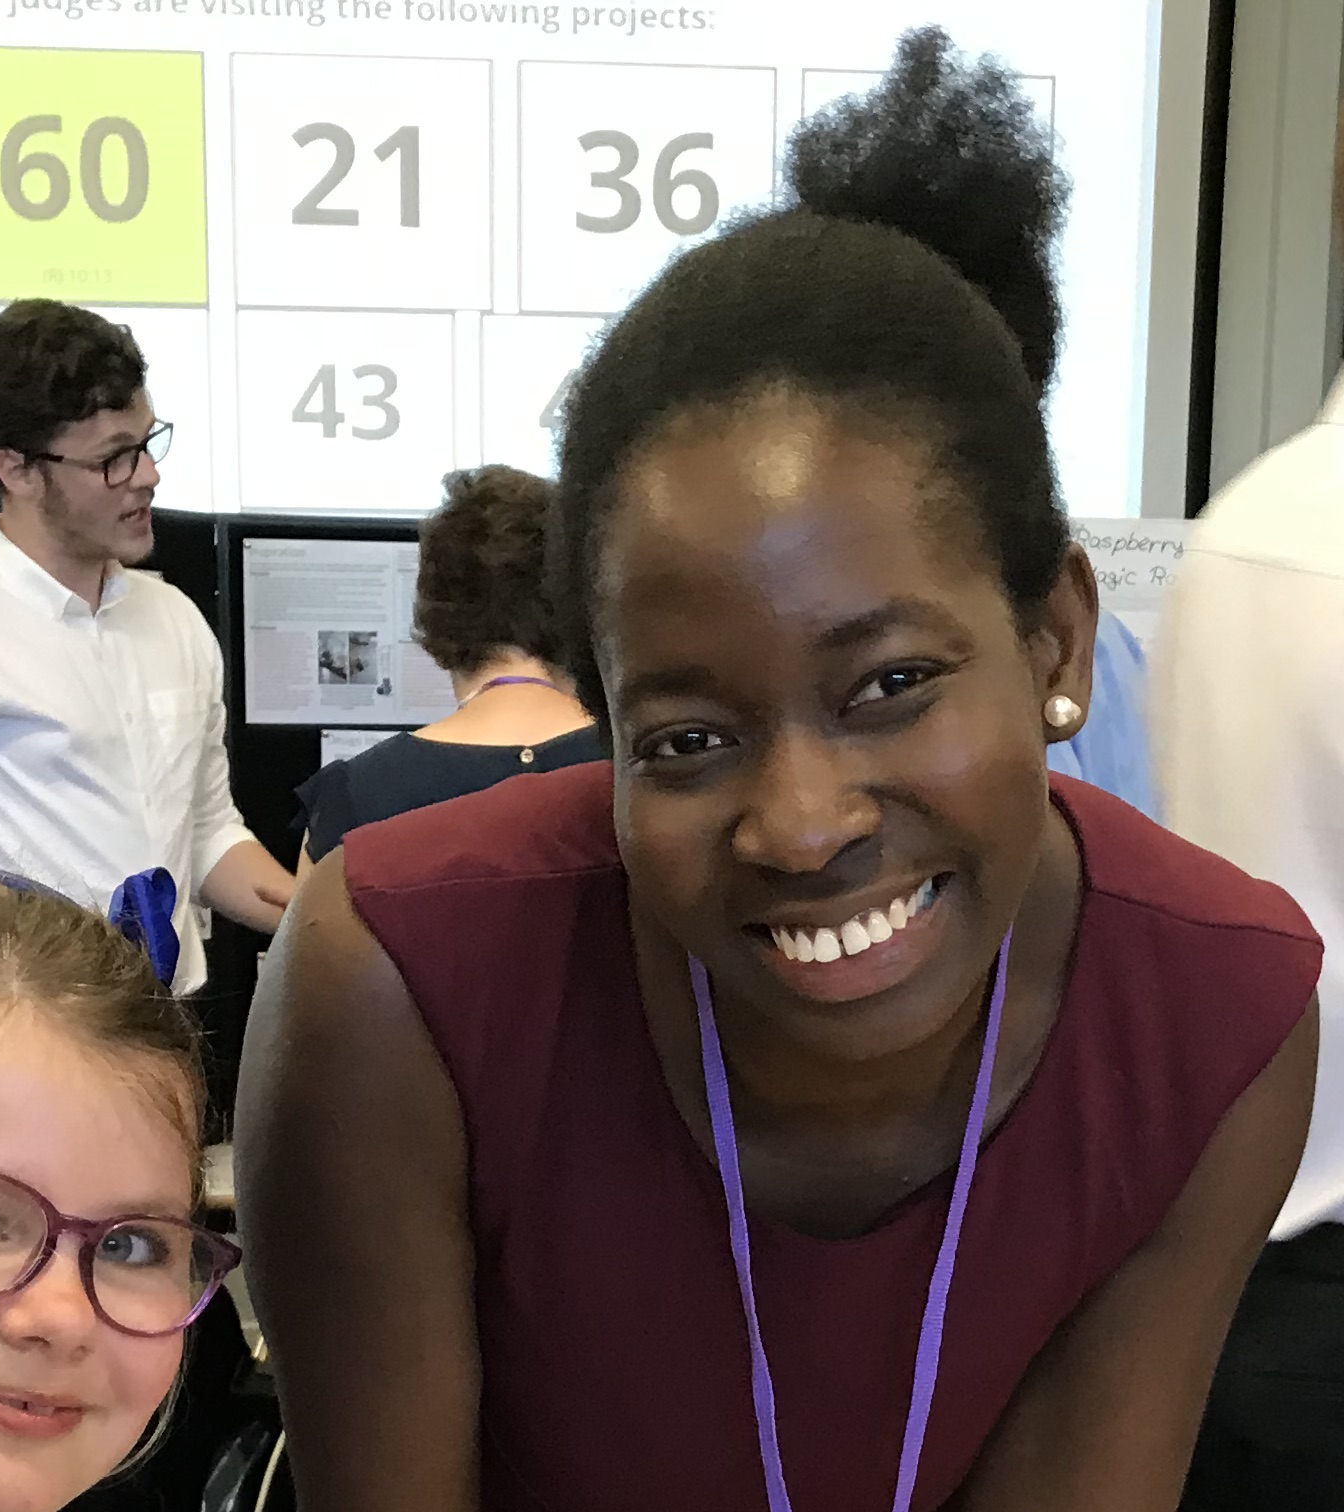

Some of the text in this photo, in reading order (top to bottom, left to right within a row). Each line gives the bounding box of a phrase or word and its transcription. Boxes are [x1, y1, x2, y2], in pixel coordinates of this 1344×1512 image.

[201, 0, 327, 27] visiting
[337, 0, 391, 20] the
[405, 0, 560, 34] following
[572, 1, 717, 36] projects:
[0, 114, 150, 224] 60
[291, 121, 420, 228] 21
[576, 129, 719, 236] 36
[291, 363, 401, 441] 43
[1076, 528, 1183, 559] Raspberry
[1093, 567, 1137, 591] agic
